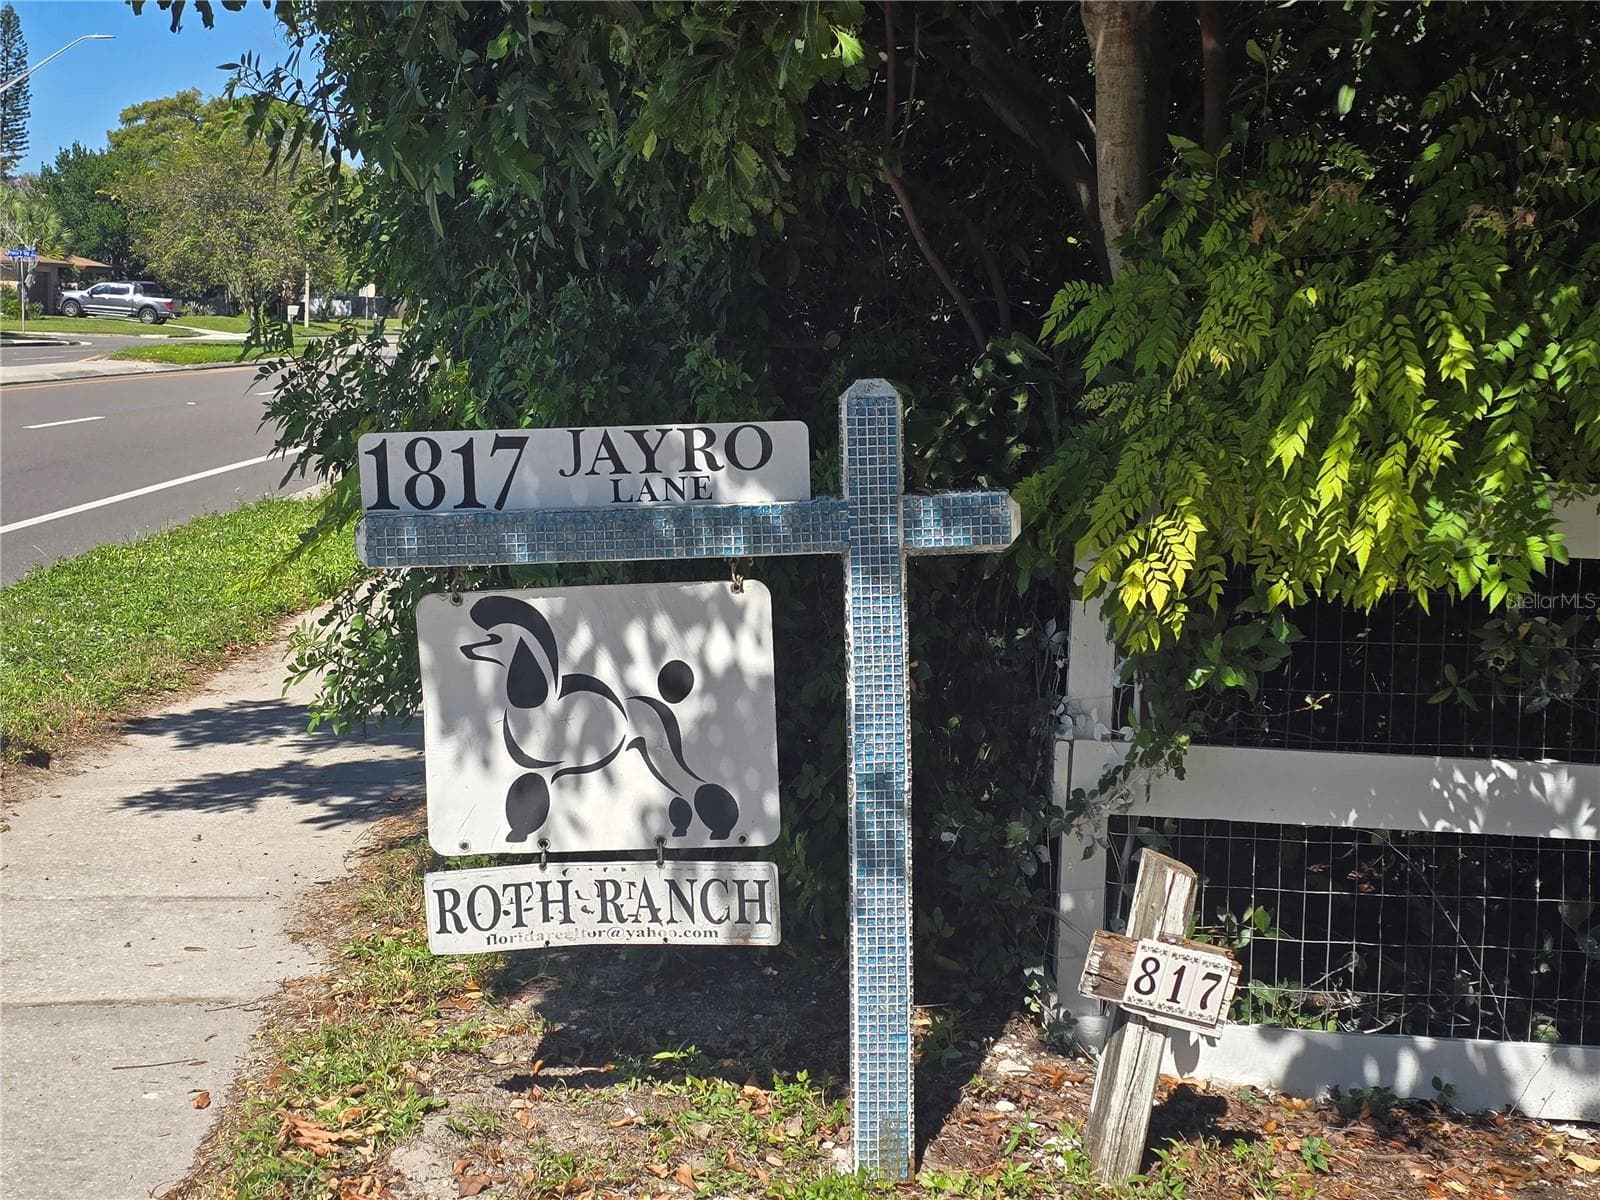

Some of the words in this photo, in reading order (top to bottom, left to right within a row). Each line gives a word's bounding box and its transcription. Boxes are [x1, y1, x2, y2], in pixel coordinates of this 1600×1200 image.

[364, 433, 530, 511] 1817
[559, 424, 773, 477] JAYRO
[610, 475, 713, 503] LANE
[432, 879, 576, 935] ROTH
[594, 876, 772, 925] RANCH
[1133, 956, 1222, 1010] 817
